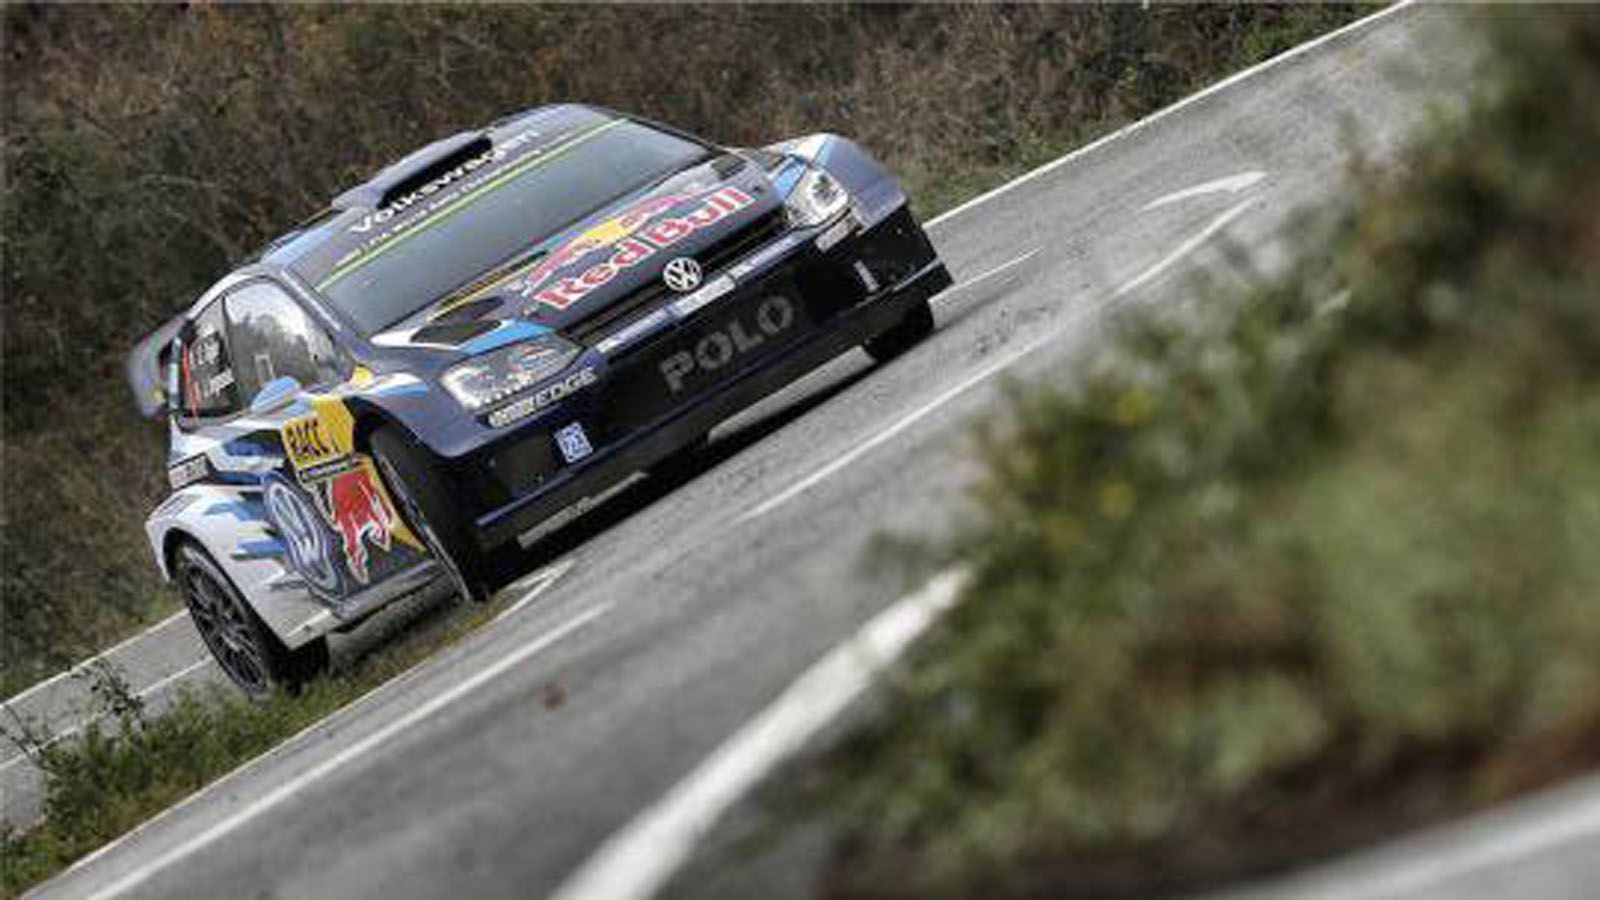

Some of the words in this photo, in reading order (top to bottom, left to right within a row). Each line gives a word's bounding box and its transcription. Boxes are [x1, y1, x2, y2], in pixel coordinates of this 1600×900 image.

[350, 128, 540, 232] Volkswagen
[533, 233, 657, 310] Red
[637, 186, 755, 249] Bull
[536, 370, 598, 407] EDGE
[659, 296, 795, 392] POLO
